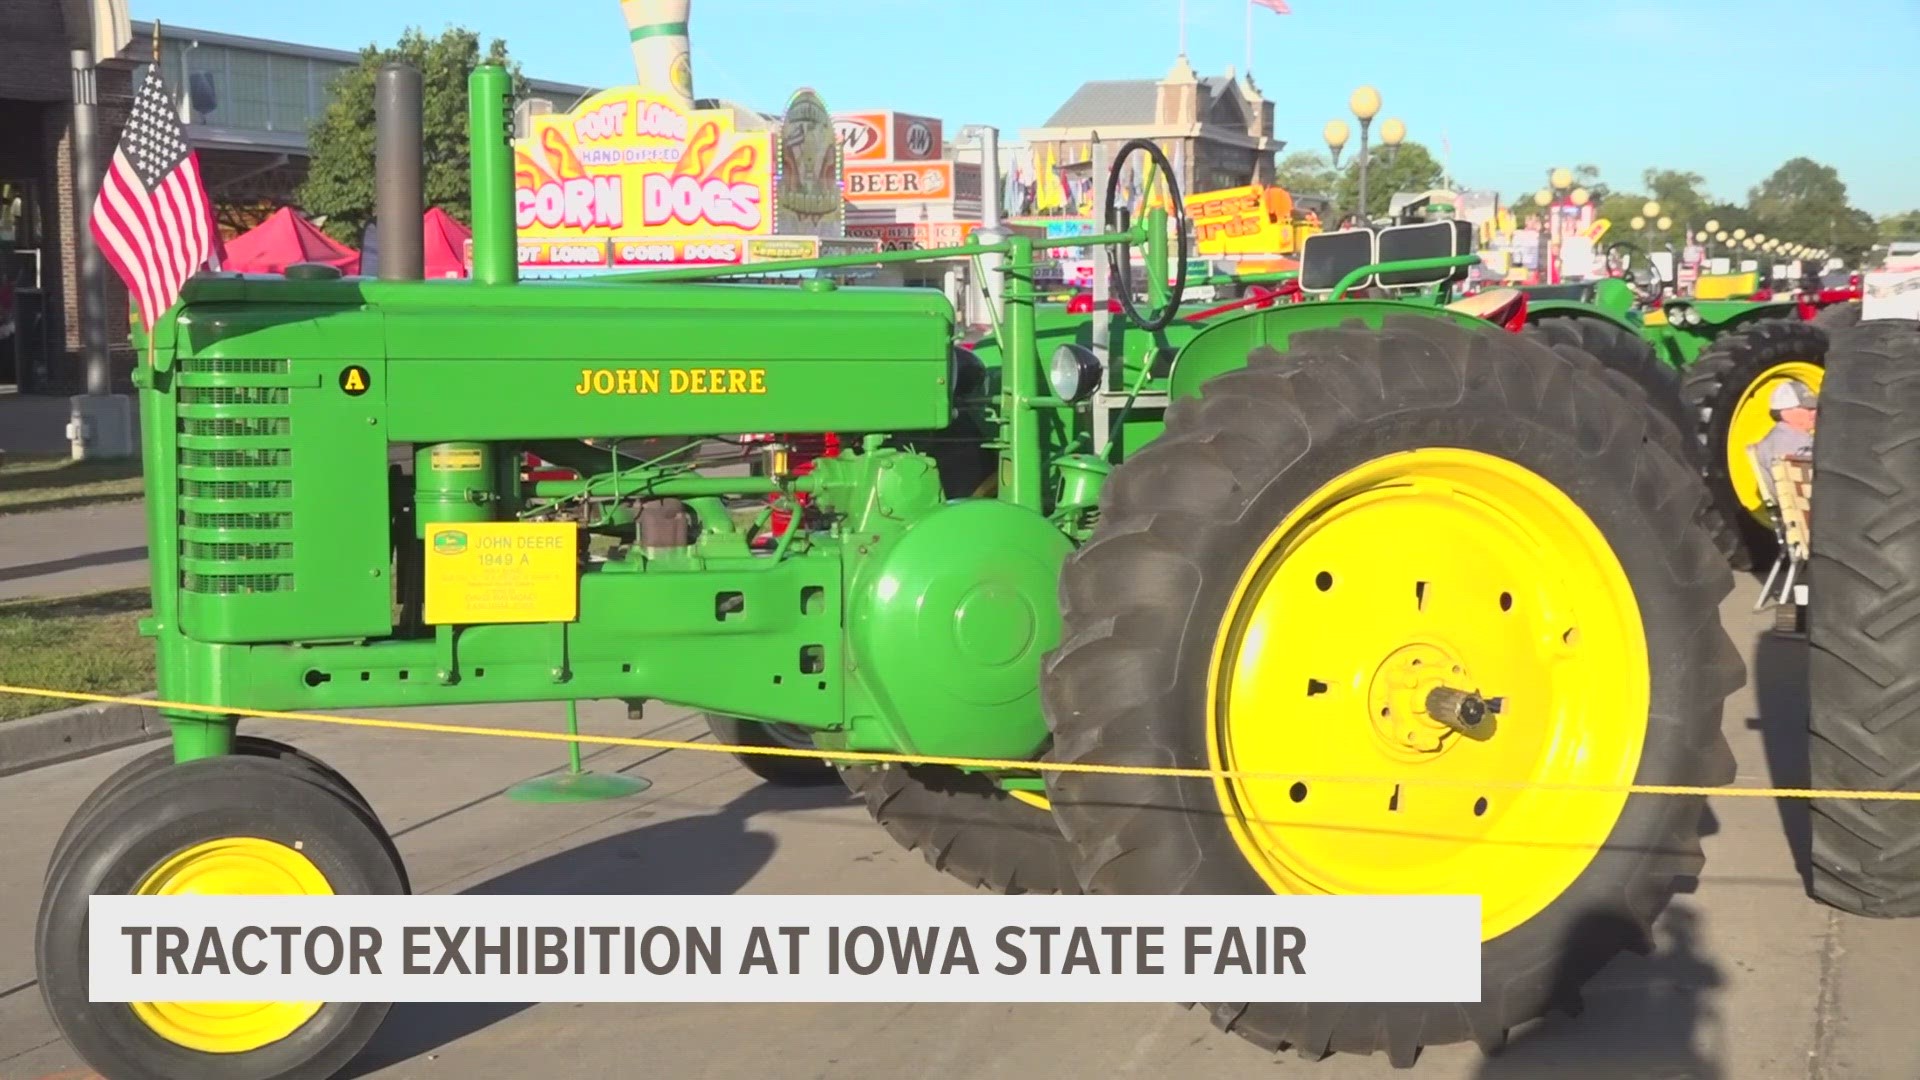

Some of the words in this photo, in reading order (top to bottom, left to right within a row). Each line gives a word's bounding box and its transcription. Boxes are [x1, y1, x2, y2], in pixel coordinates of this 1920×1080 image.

[574, 100, 627, 143] FOOT
[636, 100, 687, 141] LONG
[582, 148, 620, 162] HAND
[625, 148, 680, 160] DIPPED
[850, 173, 919, 193] BEER
[517, 174, 623, 232] CORN
[643, 173, 761, 231] DOGS
[888, 226, 925, 238] BEER
[550, 246, 599, 263] LONG
[622, 245, 675, 261] CORN
[684, 244, 736, 260] DOGS
[344, 368, 366, 390] A
[576, 369, 660, 395] JOHN
[669, 368, 767, 395] DEERE
[475, 537, 512, 549] JOHN
[517, 536, 563, 549] DEERE
[479, 554, 513, 566] 1949
[520, 554, 529, 566] A
